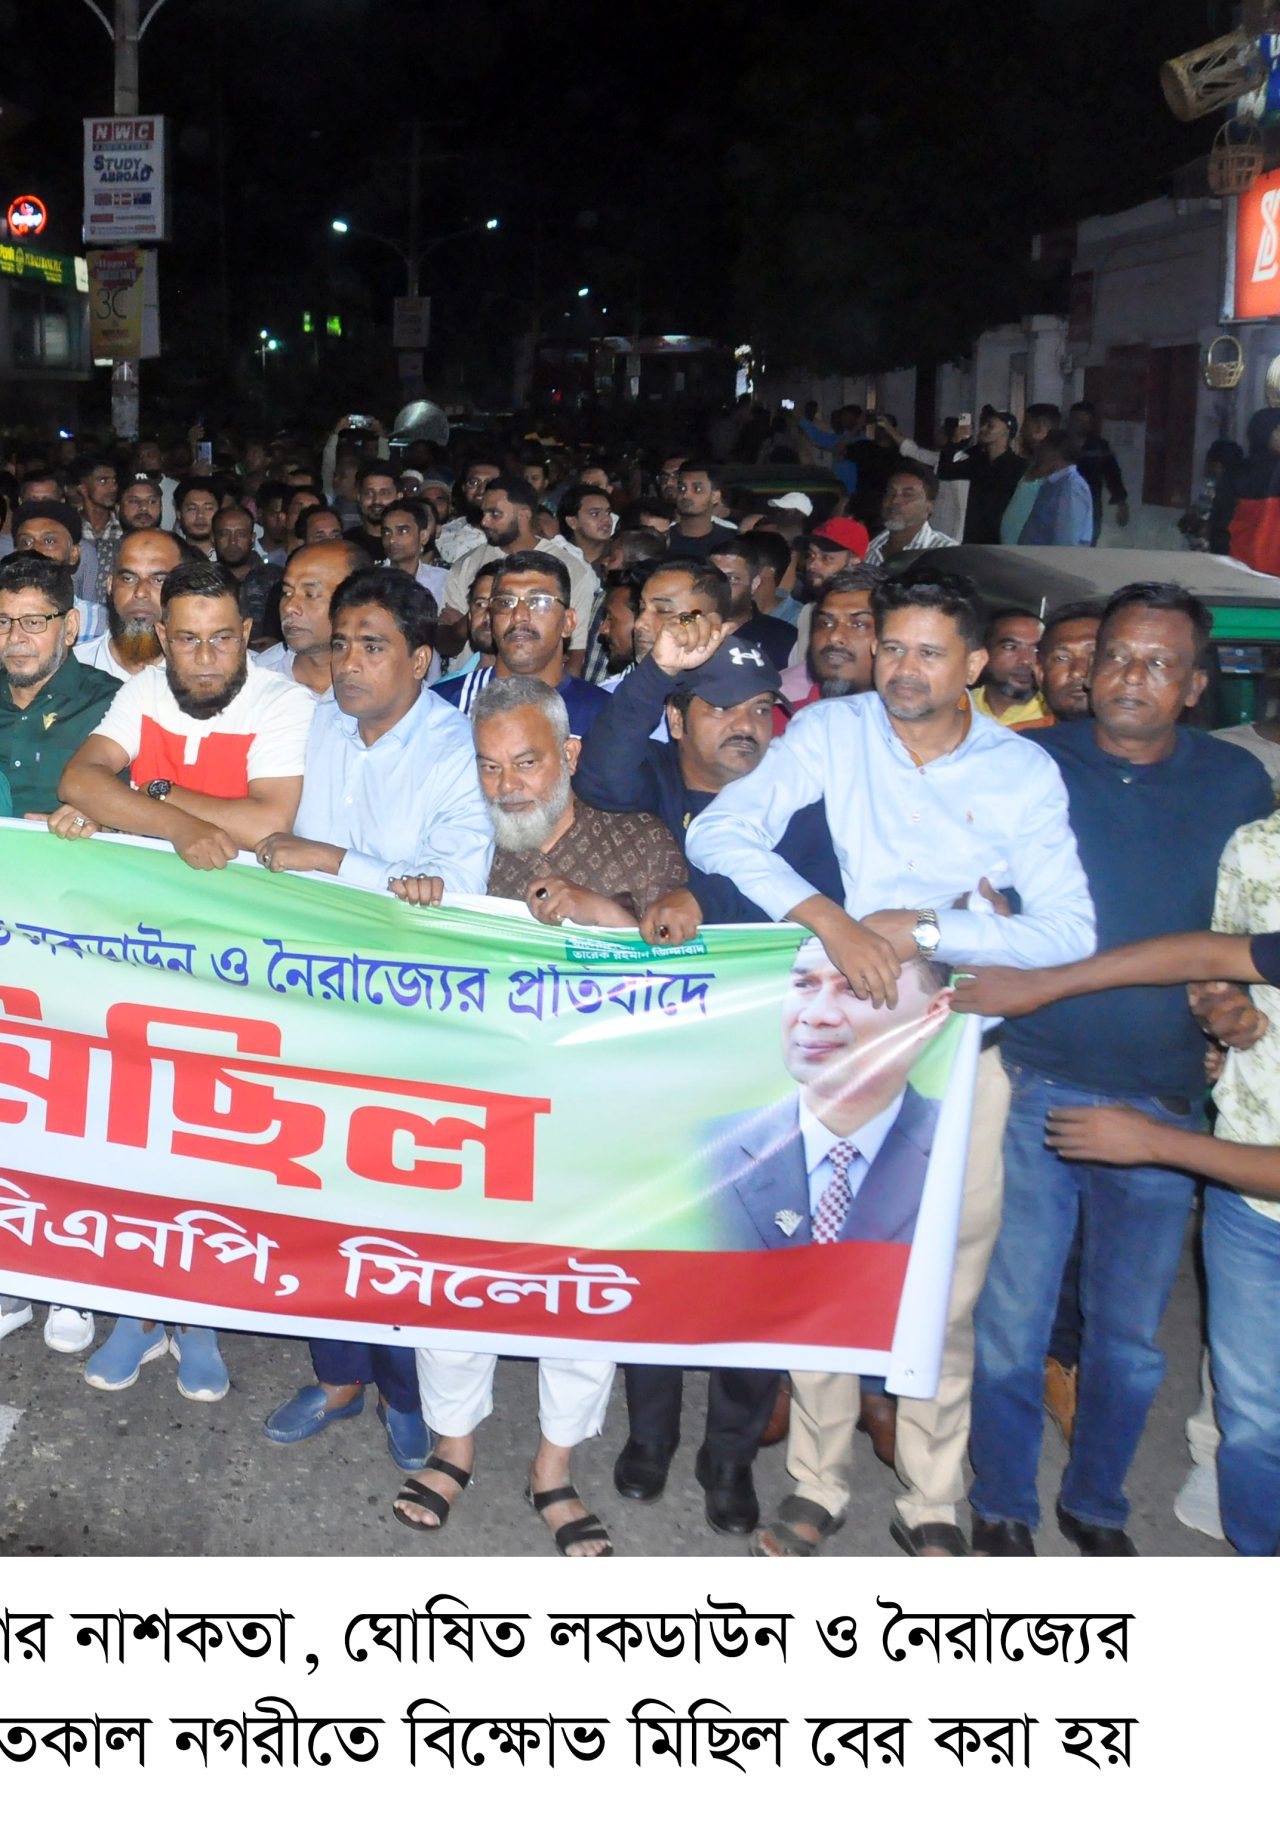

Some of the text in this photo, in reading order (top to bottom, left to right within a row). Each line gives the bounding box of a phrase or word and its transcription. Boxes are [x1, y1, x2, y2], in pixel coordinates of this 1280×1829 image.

[96, 123, 150, 140] NWC
[94, 155, 141, 171] STUDY
[100, 167, 150, 182] ABROAD
[210, 947, 250, 987] ও
[265, 938, 490, 1013] নৈরাজ্যের
[337, 1234, 641, 1316] সিলেট
